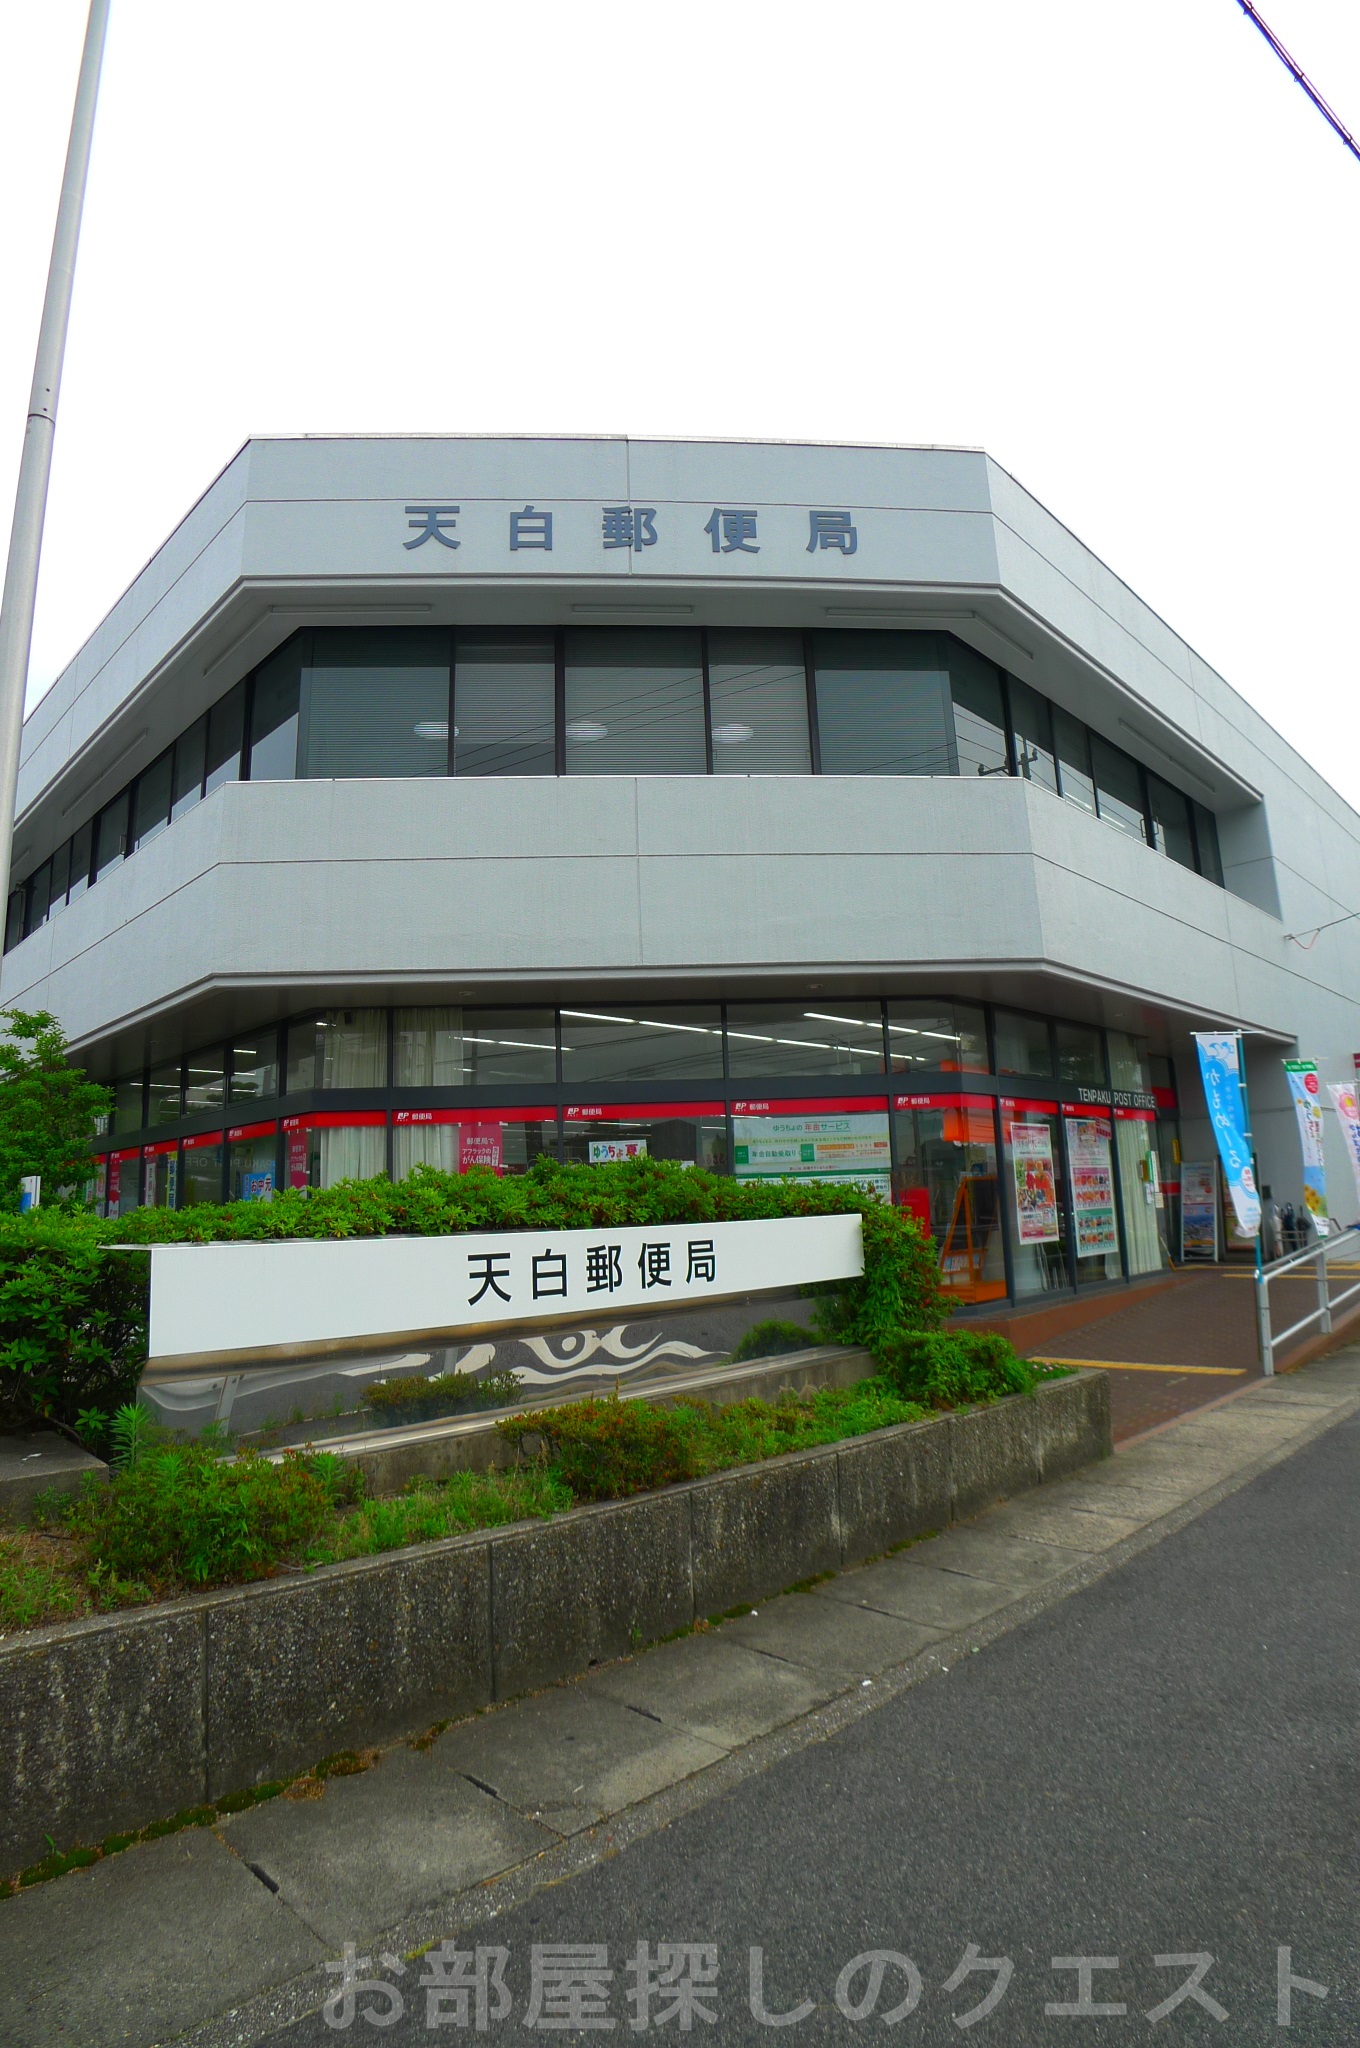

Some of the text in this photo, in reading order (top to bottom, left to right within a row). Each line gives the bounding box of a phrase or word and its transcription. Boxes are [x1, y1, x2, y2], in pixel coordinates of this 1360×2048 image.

[402, 505, 859, 554] 天白郵便局
[1078, 1087, 1156, 1109] TENPAKU POST OFFICE
[411, 1112, 433, 1121] 郵便局
[581, 1107, 603, 1116] 郵便局
[466, 1137, 495, 1145] 郵便局で
[462, 1147, 491, 1155] アフラックの
[462, 1155, 491, 1165] がん保険
[251, 1176, 273, 1193] お中元
[467, 1239, 717, 1306] 天白郵便局
